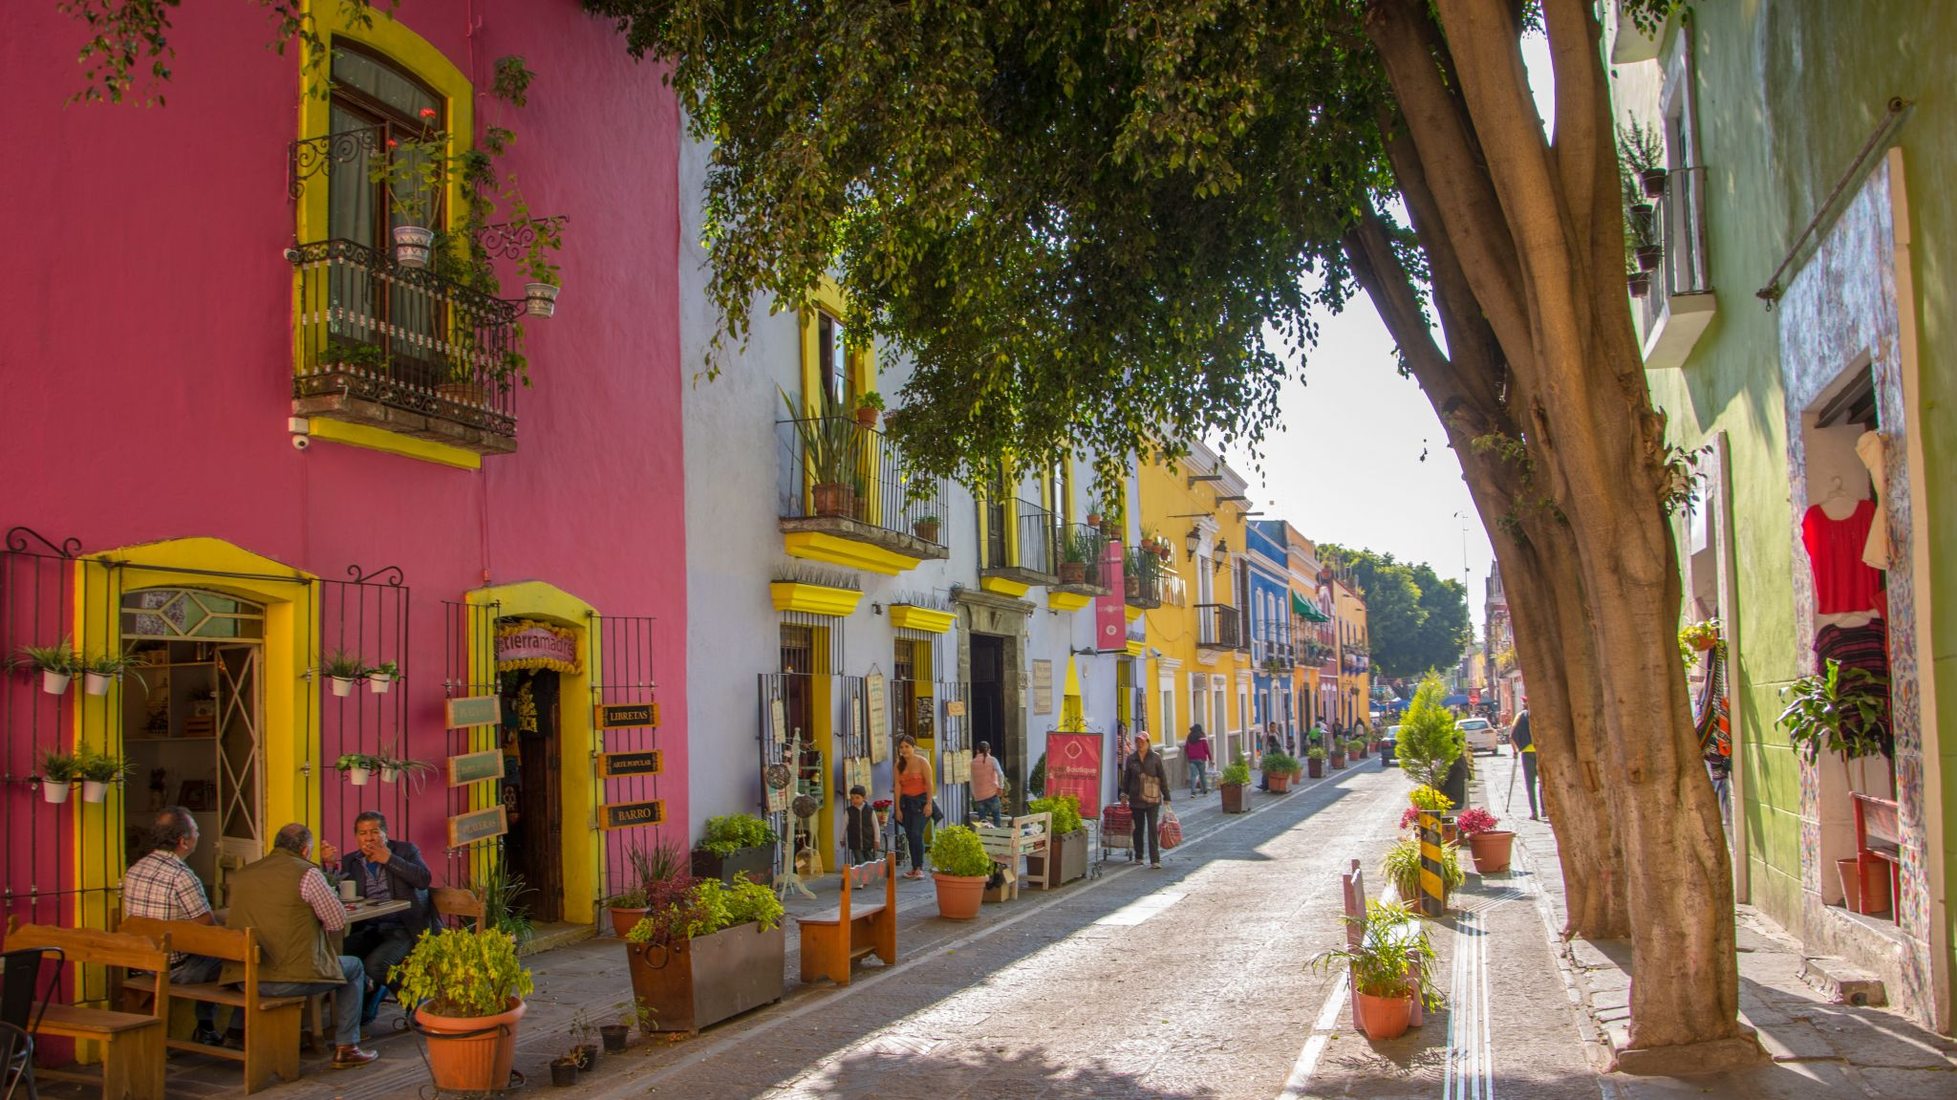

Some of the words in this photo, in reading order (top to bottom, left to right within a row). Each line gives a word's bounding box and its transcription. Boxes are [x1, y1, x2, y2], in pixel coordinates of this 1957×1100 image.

[610, 711, 648, 721] LIBRETAS
[628, 759, 651, 767] POPULAR
[618, 808, 651, 821] BARRO
